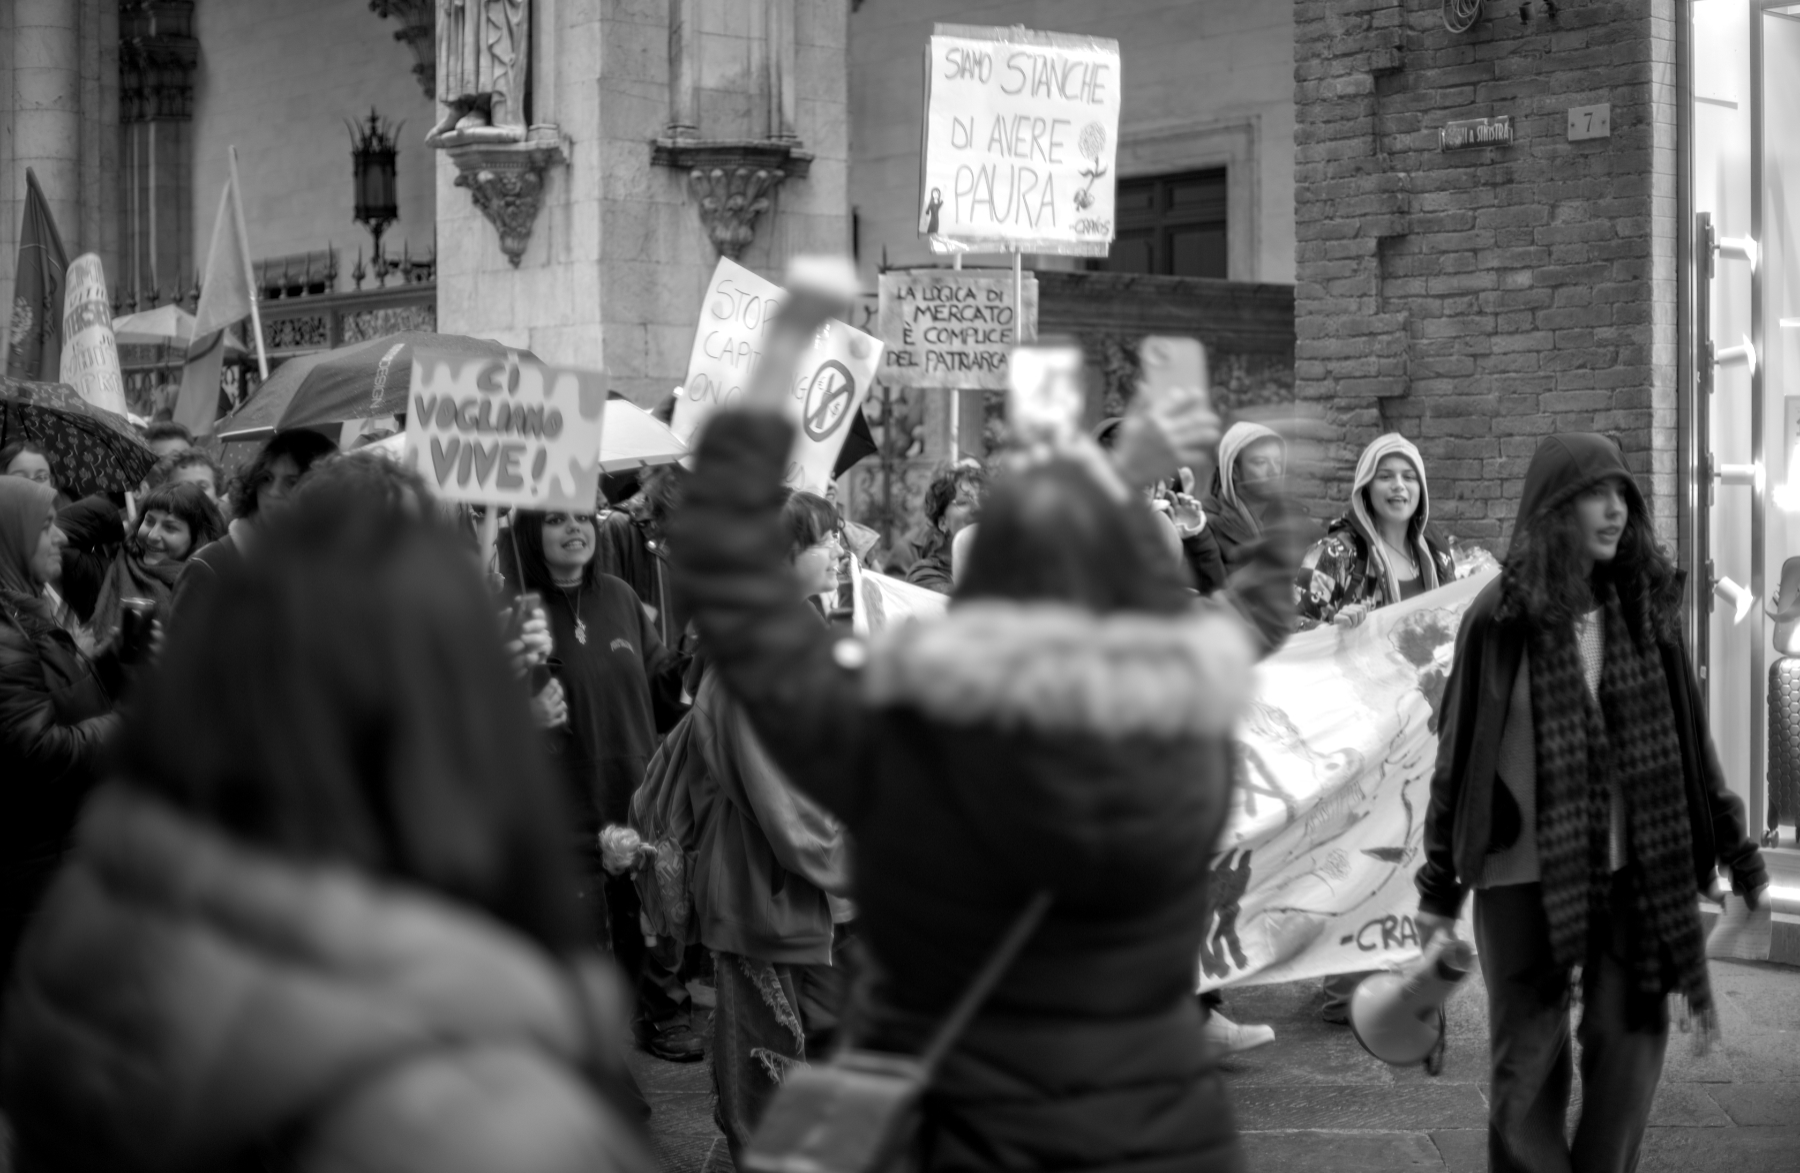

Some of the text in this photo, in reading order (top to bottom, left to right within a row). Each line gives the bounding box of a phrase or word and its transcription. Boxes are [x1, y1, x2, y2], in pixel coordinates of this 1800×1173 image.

[944, 47, 1110, 105] SIAMO STANCHE
[951, 113, 1071, 165] DI AVERE
[1476, 121, 1510, 143] SINISTRA
[1583, 112, 1594, 133] 7
[955, 163, 1056, 229] PAURA
[711, 279, 781, 337] STOP
[896, 286, 916, 301] LA
[986, 288, 1004, 303] DI
[903, 320, 1014, 346] È COMPLICE
[913, 304, 1014, 326] MERCATO
[476, 358, 521, 398] CI
[886, 350, 1009, 374] DEL PATRIARCA
[369, 359, 391, 409] DESIGN
[429, 433, 548, 498] VIVE!
[1340, 913, 1419, 952] -CRA
